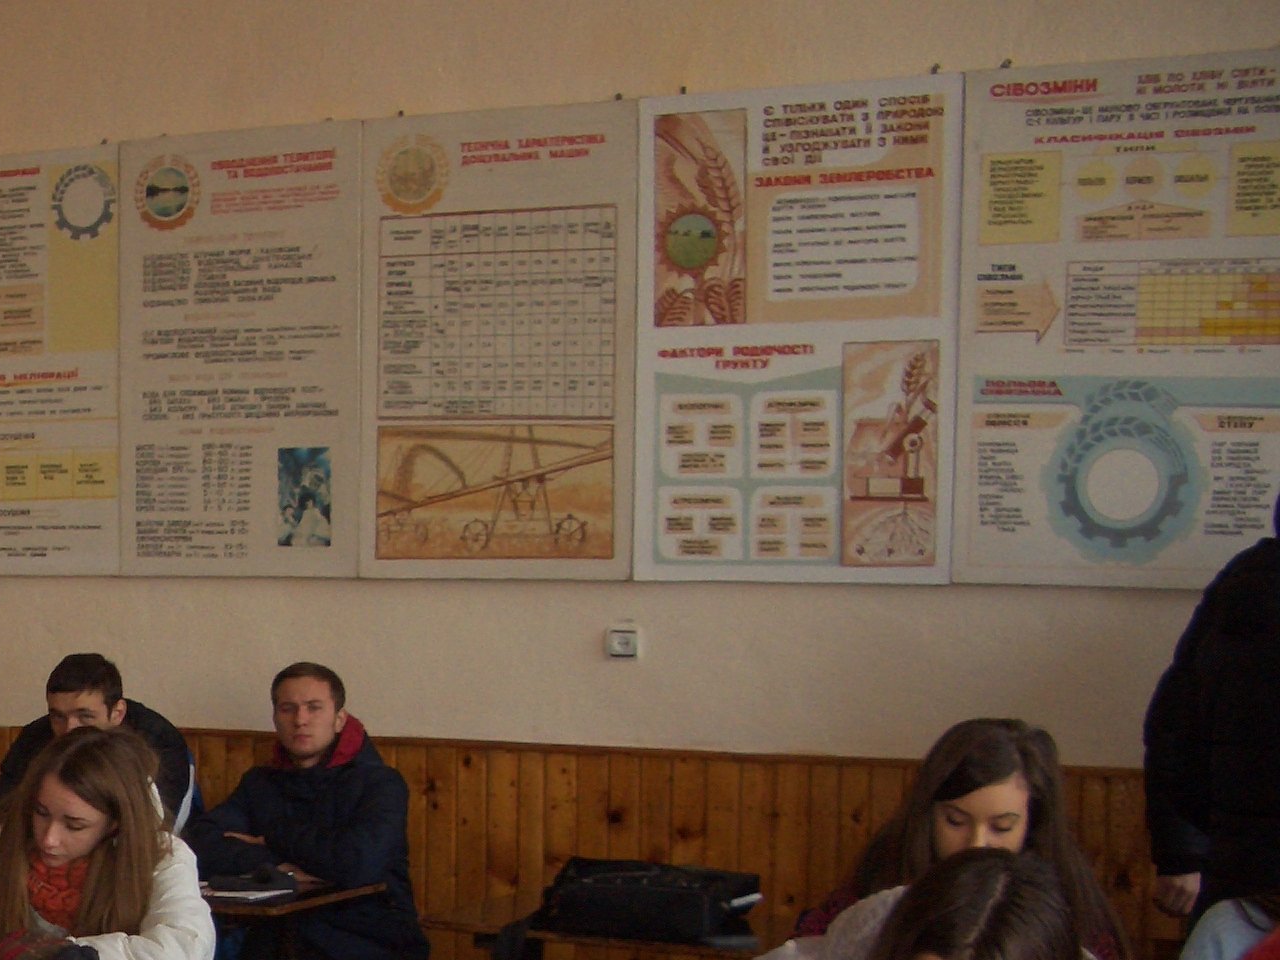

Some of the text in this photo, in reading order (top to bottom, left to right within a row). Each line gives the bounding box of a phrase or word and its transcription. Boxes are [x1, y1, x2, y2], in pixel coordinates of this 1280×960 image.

[990, 78, 1098, 97] СІВОЗМІНИ
[782, 102, 826, 115] ТІЛЬКИ
[833, 100, 868, 111] ОДИН
[878, 95, 930, 107] СПОСІБ
[880, 121, 929, 133] ЗАКОНИ
[755, 167, 934, 187] ЗАКОНИ ЗЕМЛЕРОБСТВА
